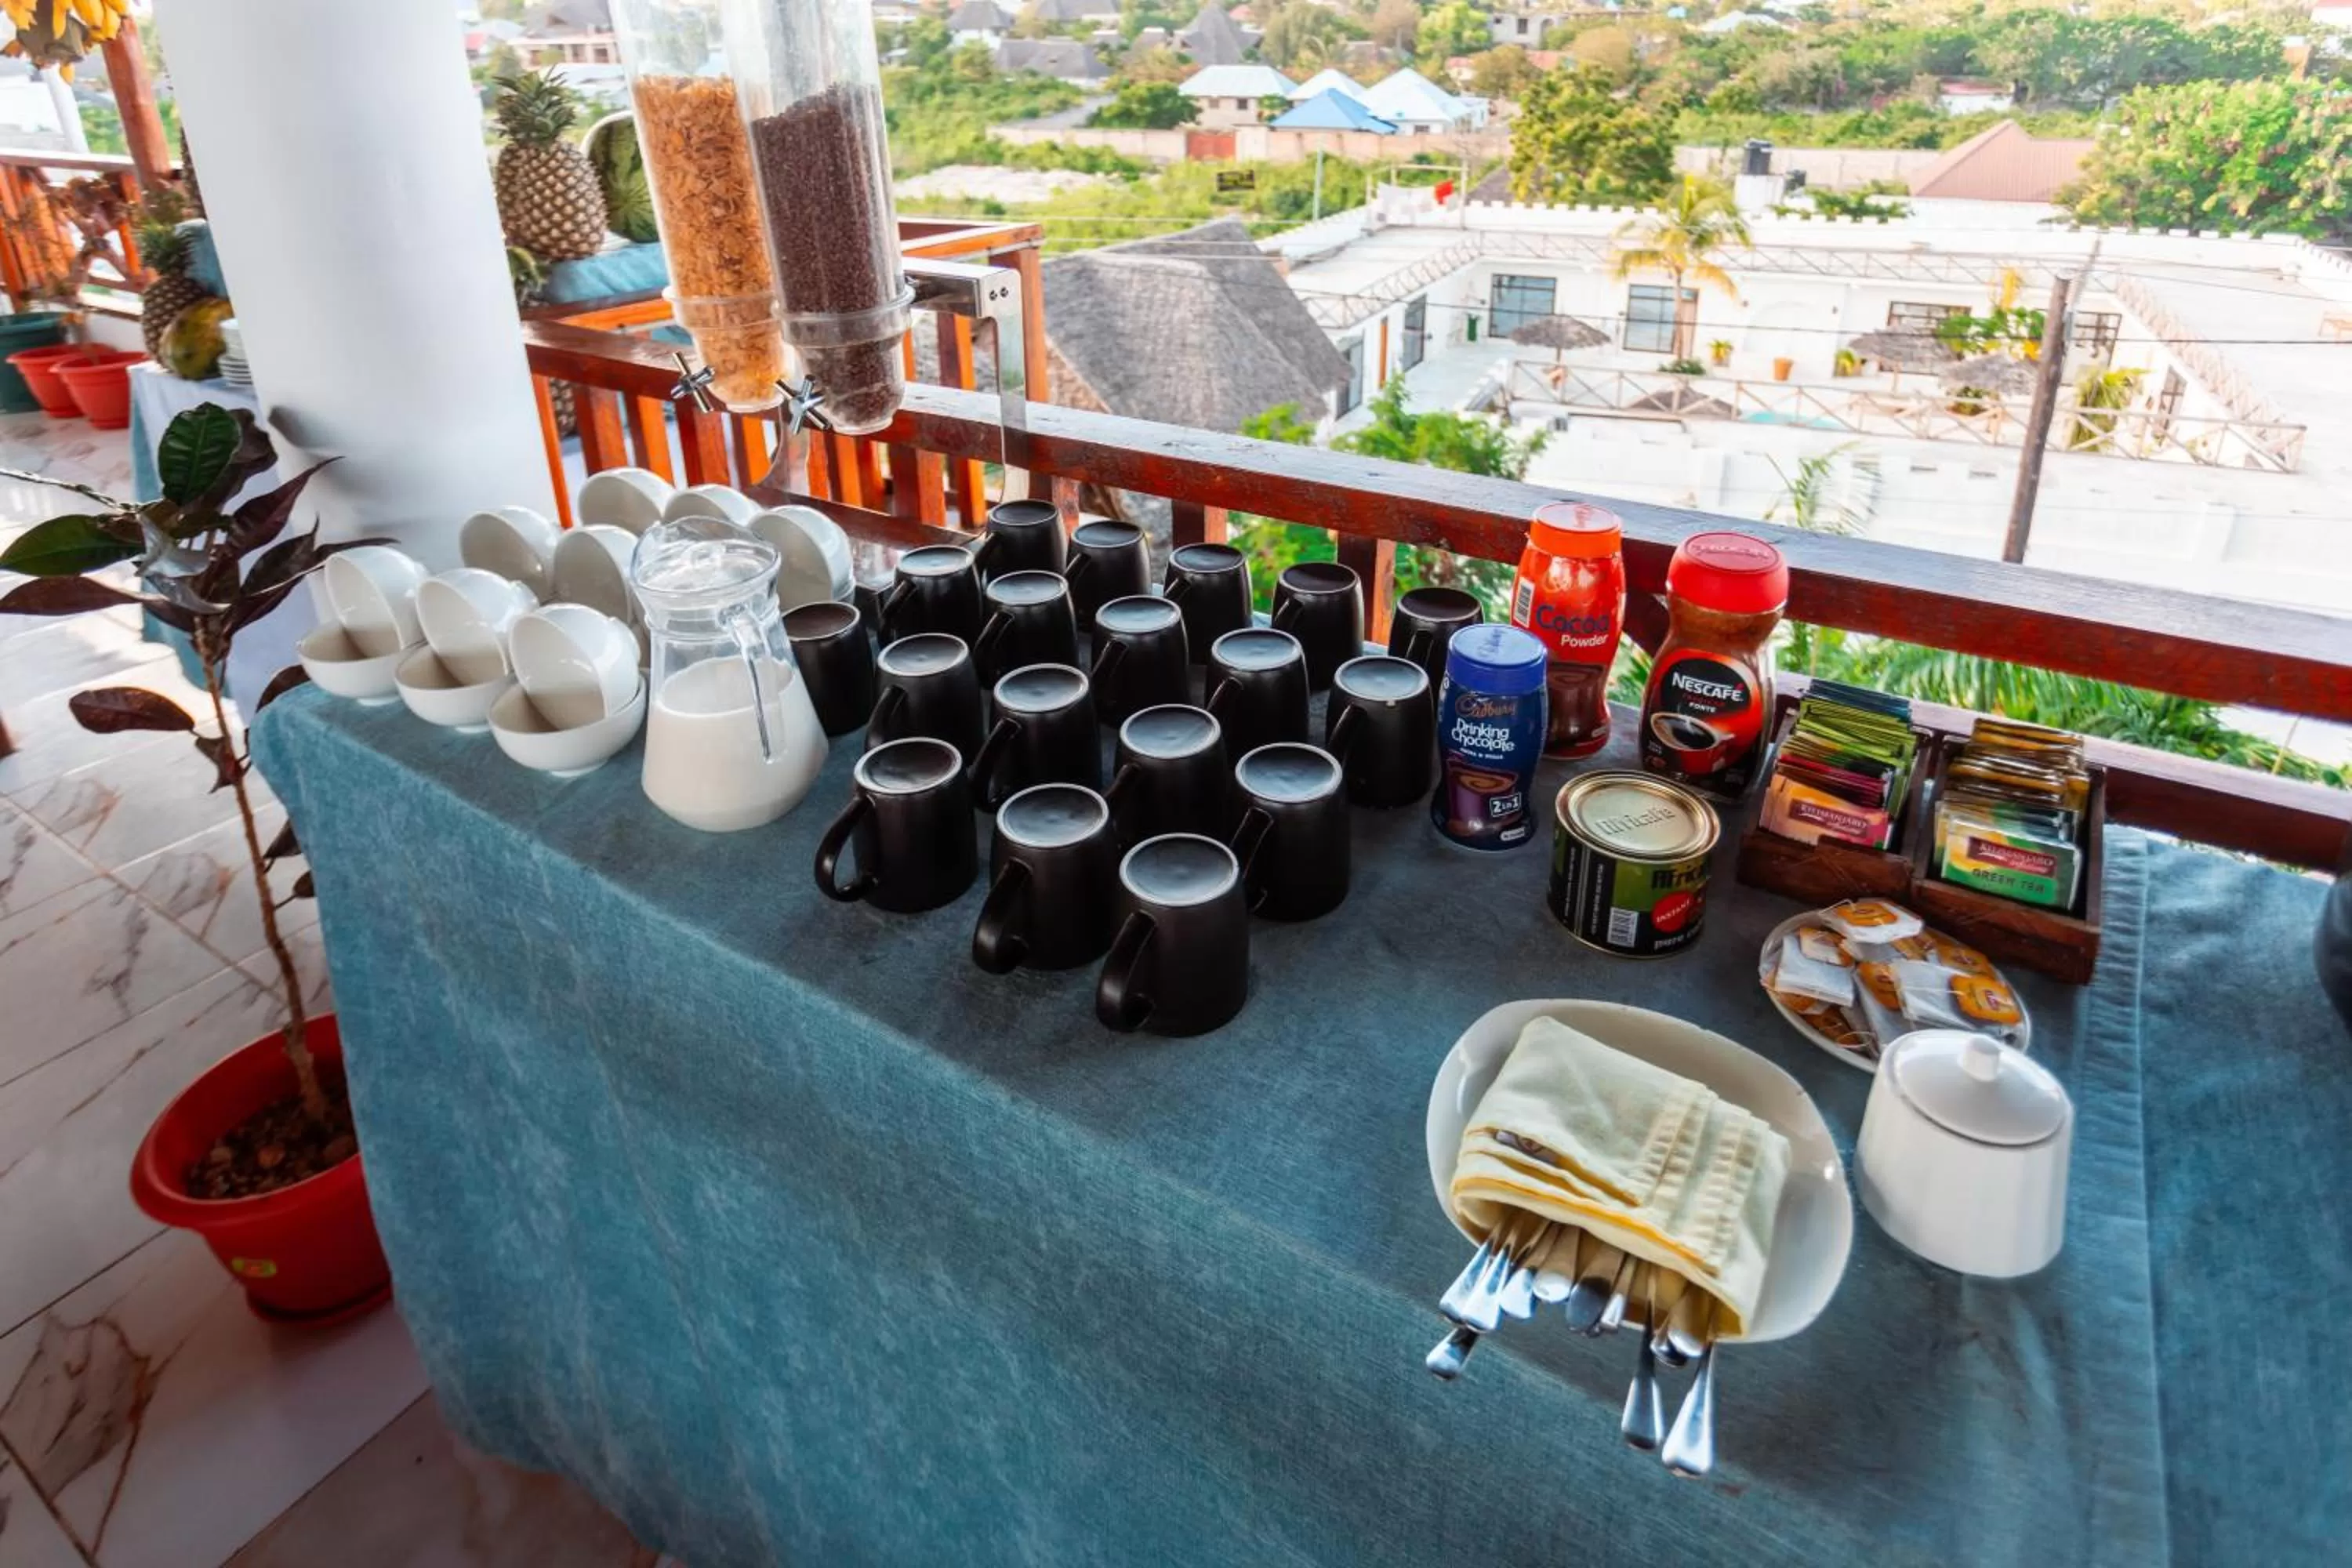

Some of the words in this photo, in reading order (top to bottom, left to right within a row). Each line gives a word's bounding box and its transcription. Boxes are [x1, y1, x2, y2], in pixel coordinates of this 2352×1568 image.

[1536, 603, 1610, 634] Cocoa
[1560, 633, 1609, 647] Powder
[1451, 727, 1515, 751] Chocolate
[1456, 717, 1509, 740] Drinking
